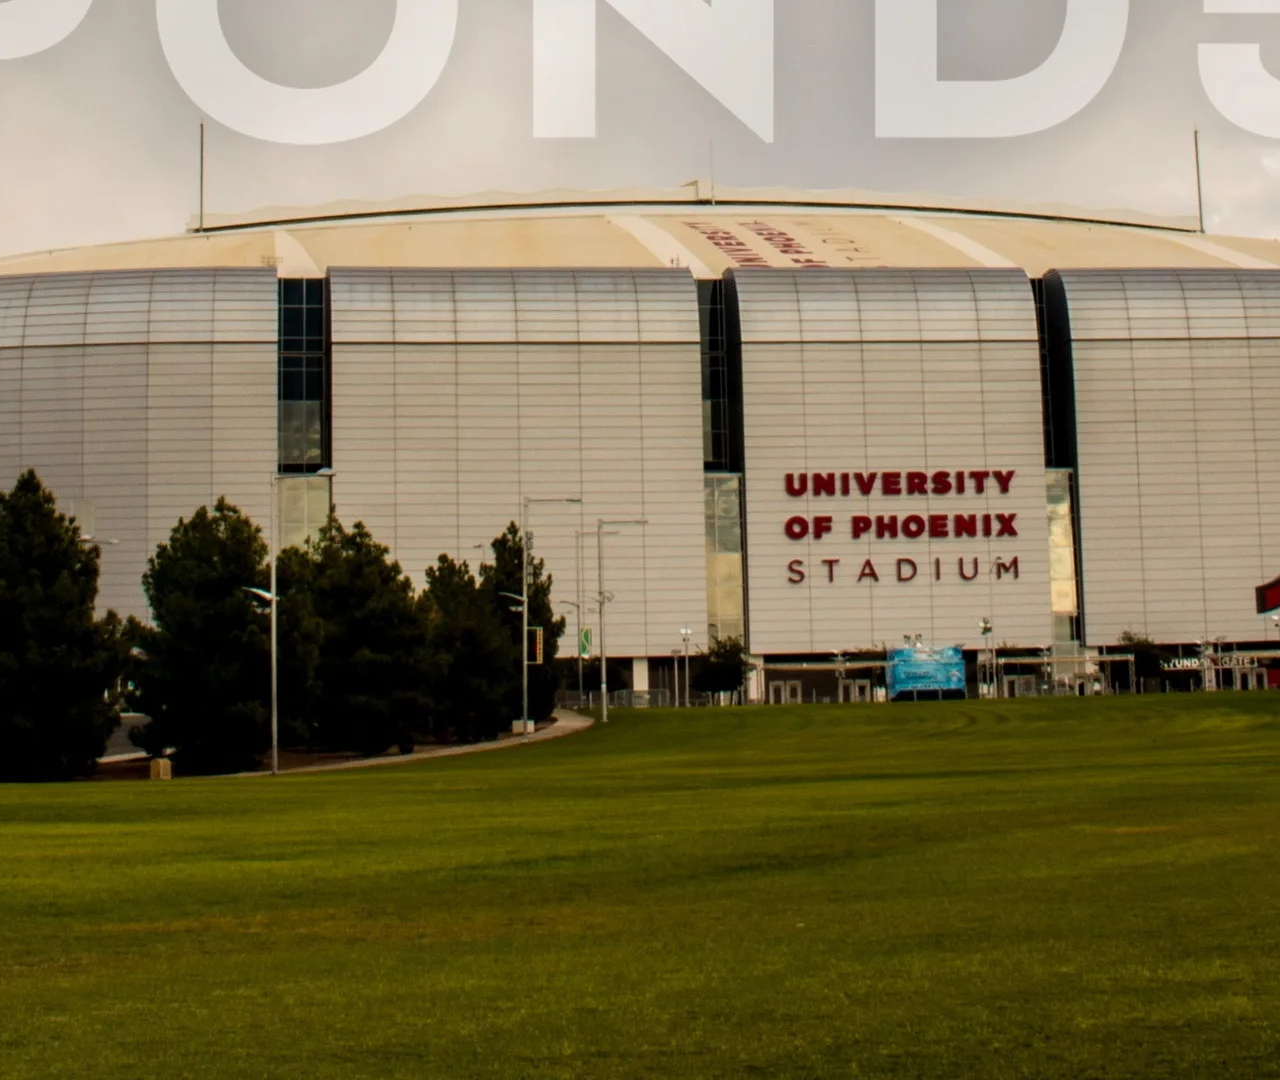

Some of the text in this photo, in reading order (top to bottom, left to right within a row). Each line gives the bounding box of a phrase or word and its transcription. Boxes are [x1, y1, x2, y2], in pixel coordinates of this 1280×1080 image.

[784, 470, 1015, 497] UNIVERSITY
[784, 513, 1018, 540] OF PHOENIX
[787, 555, 1019, 584] STADIUM
